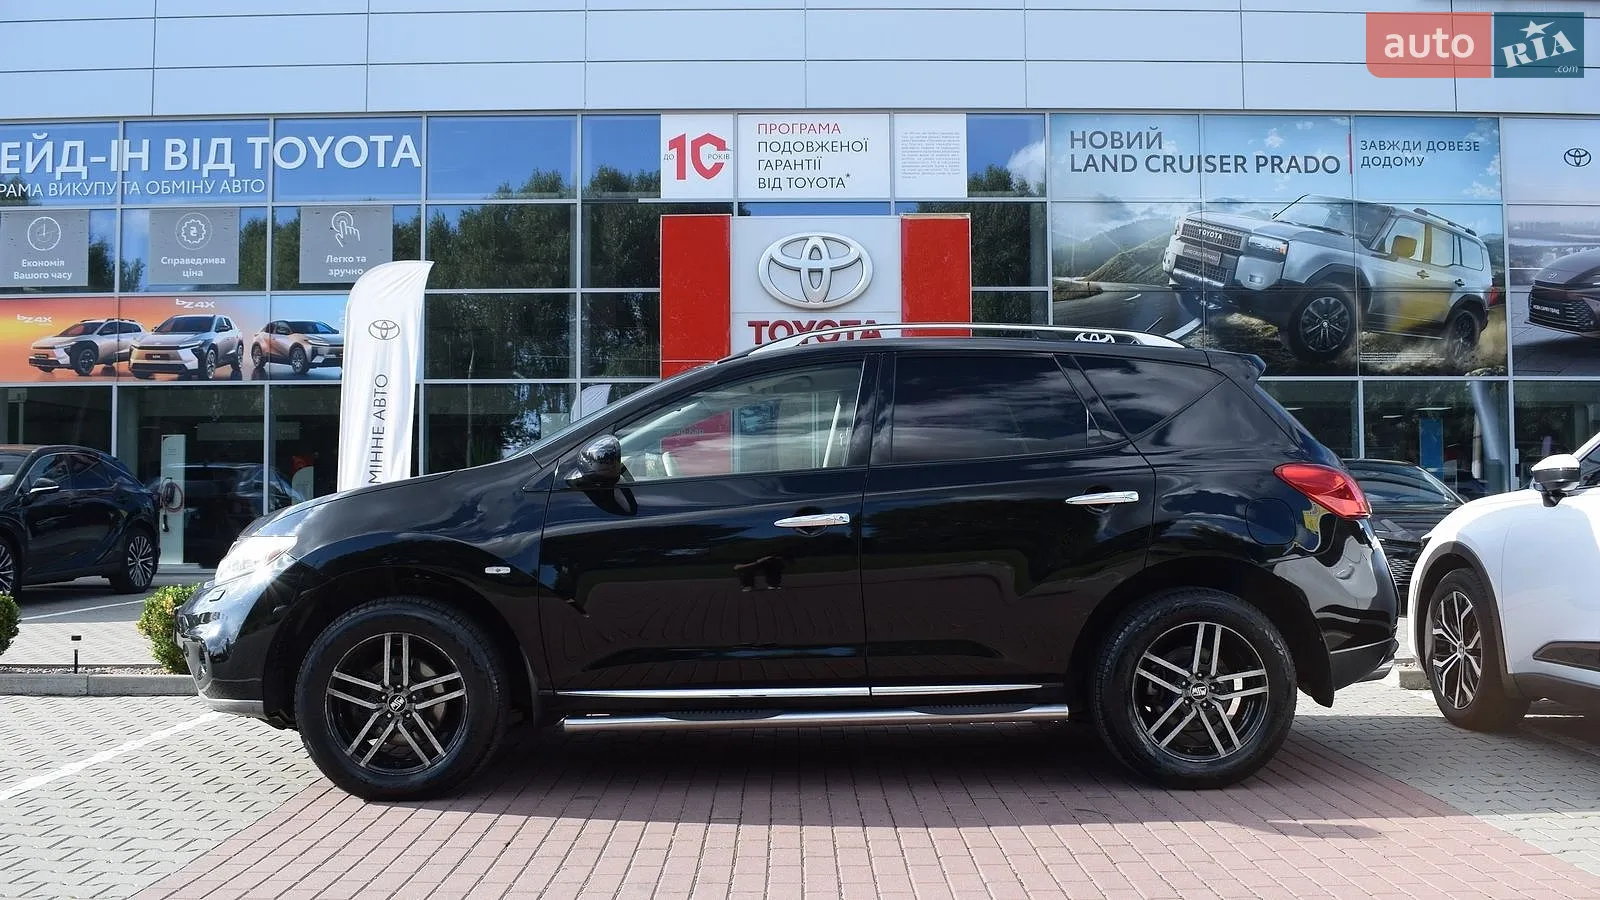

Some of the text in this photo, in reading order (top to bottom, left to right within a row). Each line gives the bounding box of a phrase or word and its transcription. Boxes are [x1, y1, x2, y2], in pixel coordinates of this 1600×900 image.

[757, 122, 842, 135] ПРОГРАМА
[1070, 126, 1163, 150] НОВИЙ
[757, 137, 869, 155] ПОДОВЖЕНОЇ
[1359, 140, 1480, 153] ЗАВЖДИ ДОВЕЗЕ
[164, 137, 236, 178] ВІД
[246, 135, 422, 170] TOYOTA
[706, 153, 730, 161] РОКІВ
[1360, 155, 1425, 169] ДОДОМУ
[757, 156, 823, 171] ГАРАНТІЇ
[1070, 153, 1341, 174] LAND CRUISER PRADO
[48, 180, 117, 197] ВИКУПУ
[122, 181, 141, 195] ТА
[145, 179, 216, 195] ОБМІНУ
[219, 178, 266, 194] АВТО
[758, 176, 783, 192] ВІД
[1198, 229, 1223, 240] TOYOTA
[21, 259, 65, 268] Економія
[160, 256, 226, 267] Справедлива
[326, 254, 355, 264] Легко
[13, 271, 73, 281] Вашого часу
[182, 268, 204, 278] ціна
[328, 268, 364, 278] зручно
[372, 373, 389, 421] АВТО
